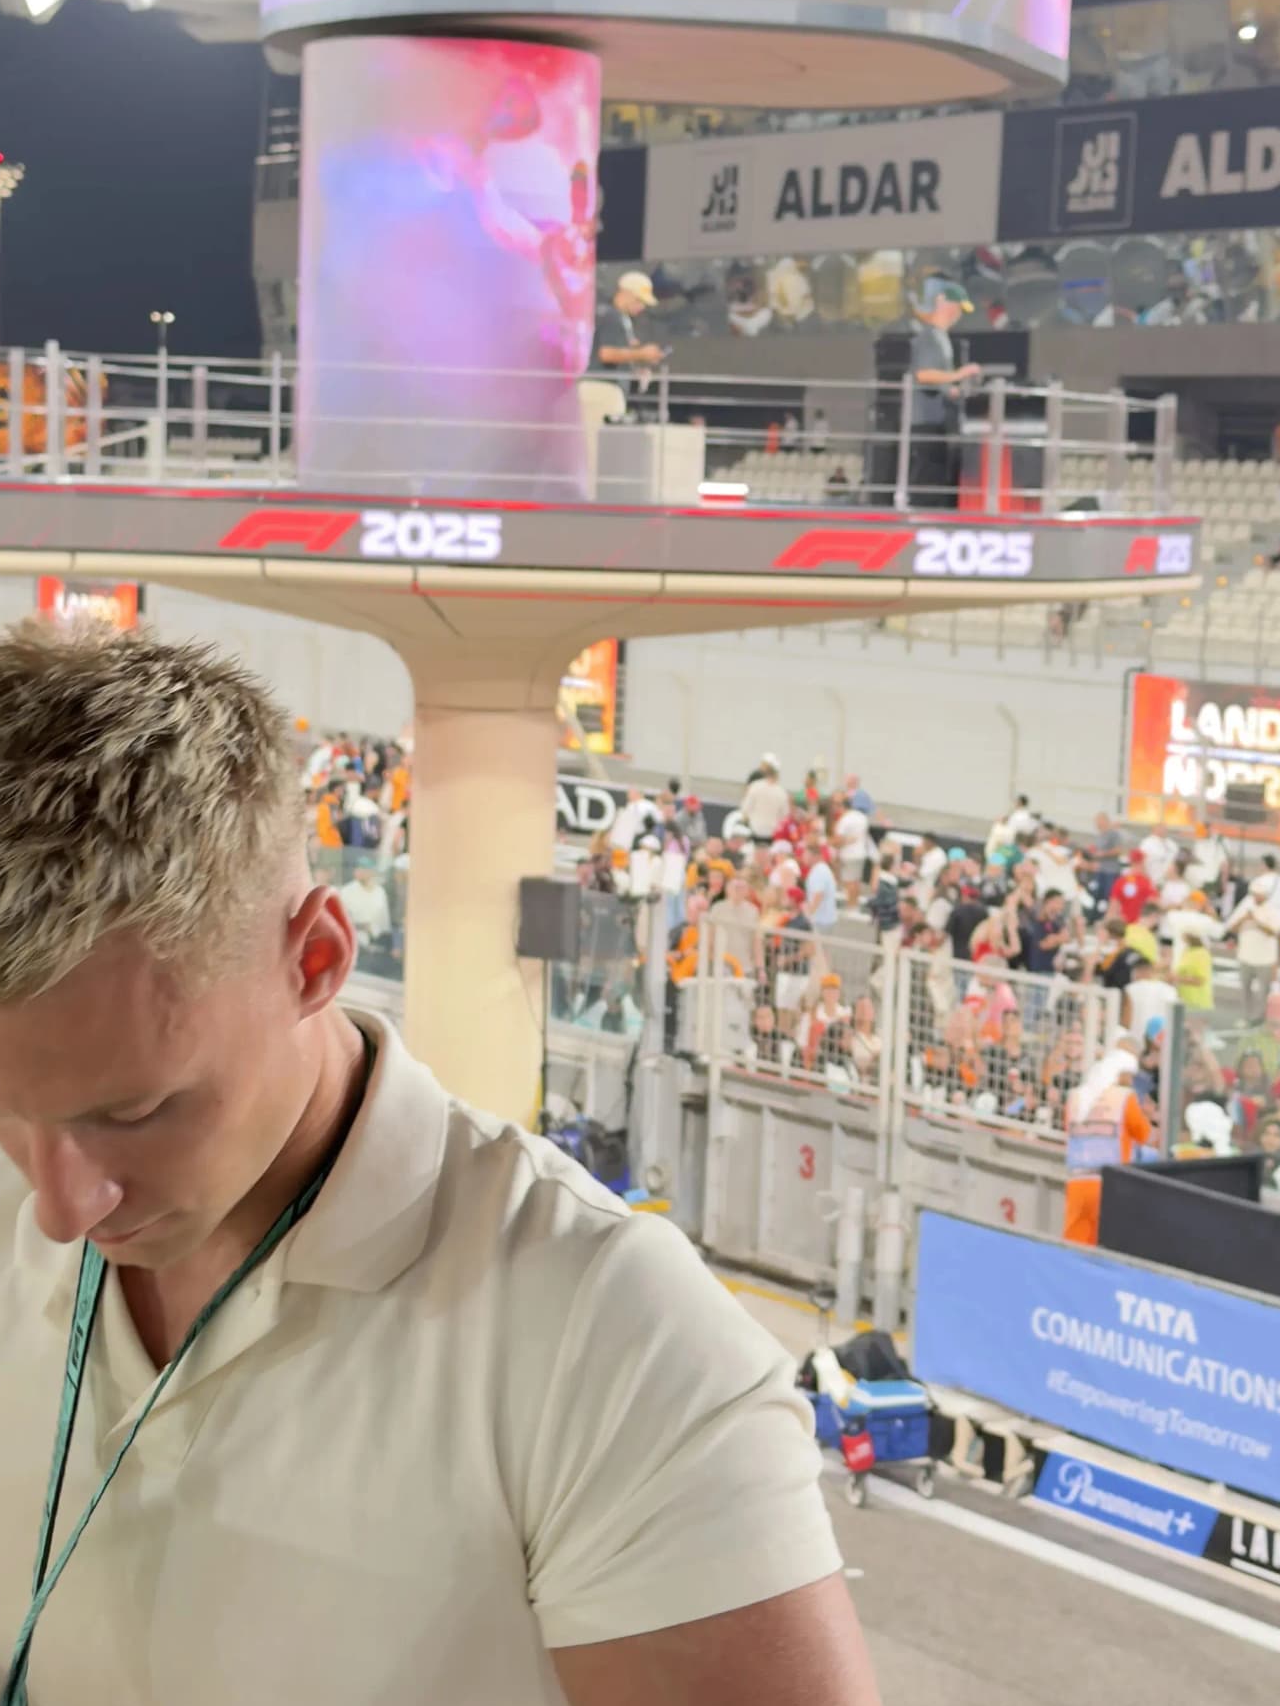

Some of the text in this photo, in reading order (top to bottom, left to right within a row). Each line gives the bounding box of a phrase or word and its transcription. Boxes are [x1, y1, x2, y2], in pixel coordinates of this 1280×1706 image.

[773, 159, 941, 222] ALDAR
[359, 510, 502, 560] 2025
[913, 528, 1036, 576] 2025
[799, 1144, 816, 1181] 3
[1116, 1289, 1198, 1345] TATA
[1053, 1460, 1197, 1536] Paramount+
